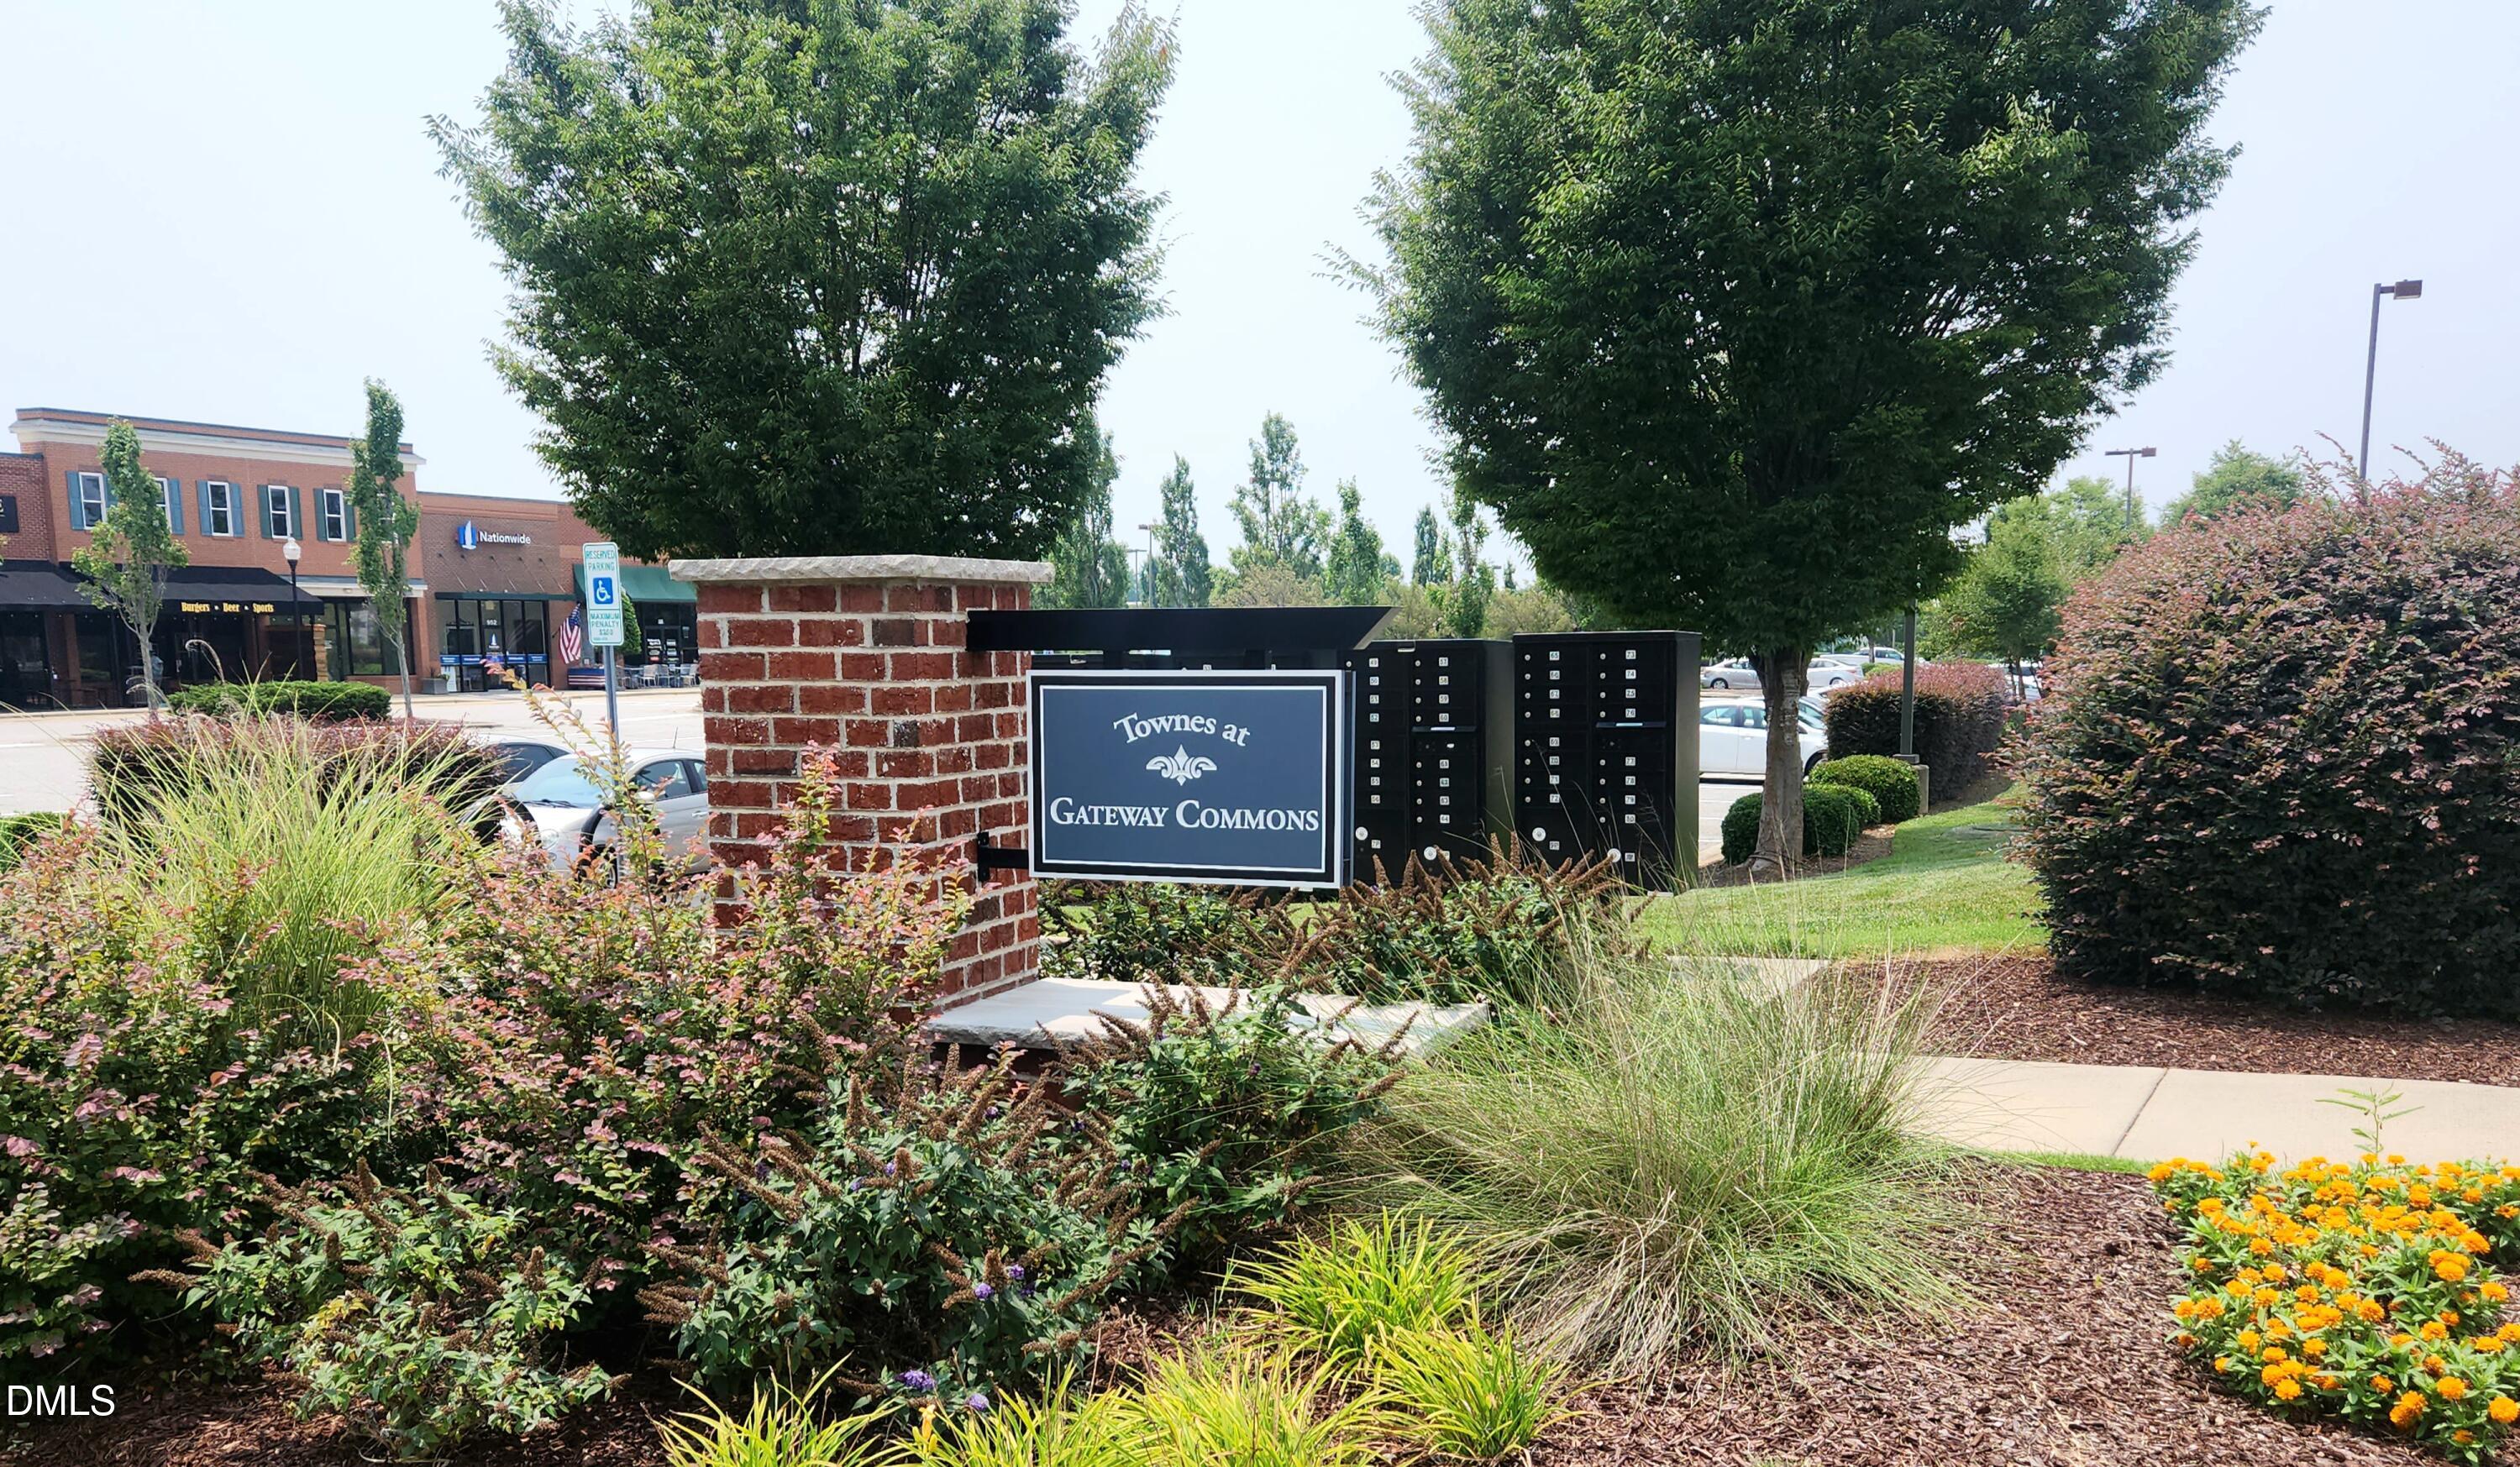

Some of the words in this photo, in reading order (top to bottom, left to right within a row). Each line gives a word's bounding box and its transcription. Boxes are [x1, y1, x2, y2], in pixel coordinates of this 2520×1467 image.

[480, 531, 531, 544] Nationwide
[585, 550, 616, 559] RESERVED
[589, 562, 615, 571] PARKING
[181, 601, 210, 613] Burgers
[223, 602, 240, 613] Beer
[253, 602, 275, 614] Sports
[1113, 712, 1217, 744] Townes
[1221, 722, 1251, 747] at
[1050, 797, 1169, 827] GATEWAY
[1175, 799, 1320, 831] COMMONS
